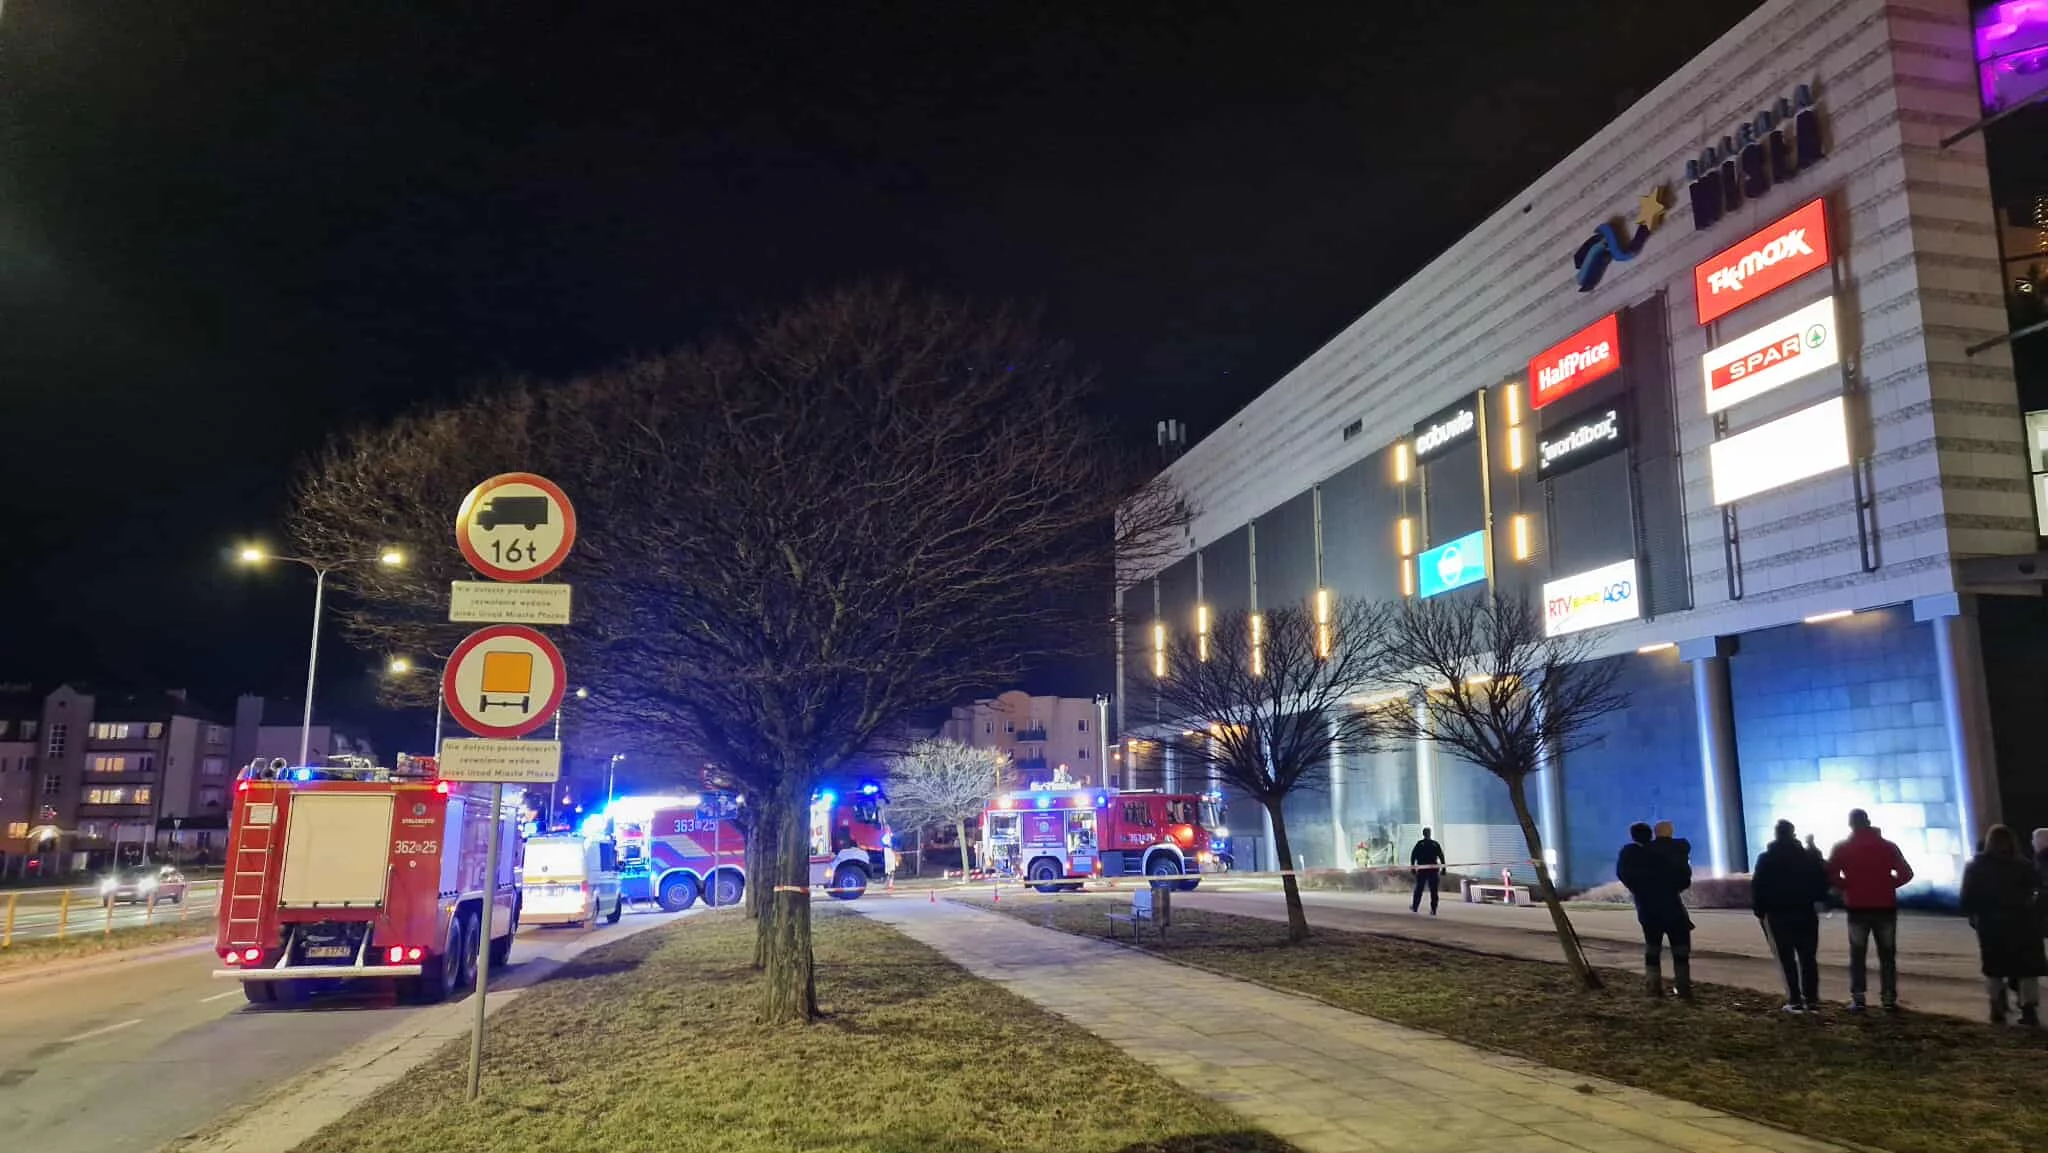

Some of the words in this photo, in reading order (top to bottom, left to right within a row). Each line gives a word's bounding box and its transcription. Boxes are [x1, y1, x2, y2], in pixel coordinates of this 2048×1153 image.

[1538, 341, 1609, 391] HalfPrice
[1729, 336, 1800, 380] SPAR
[1549, 595, 1572, 617] RTV
[1603, 581, 1631, 604] AGD
